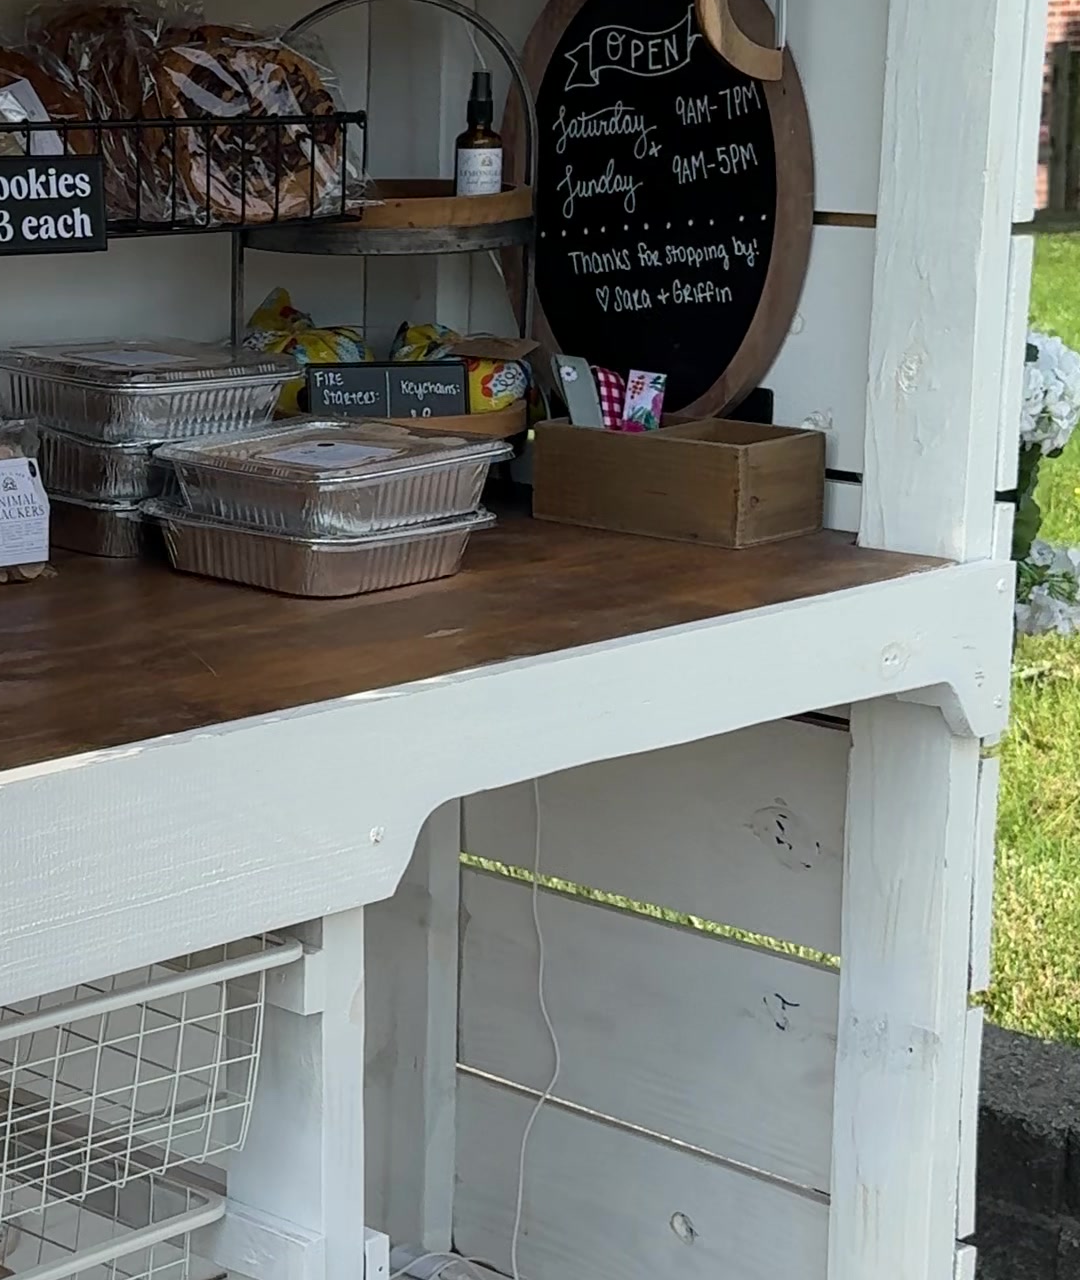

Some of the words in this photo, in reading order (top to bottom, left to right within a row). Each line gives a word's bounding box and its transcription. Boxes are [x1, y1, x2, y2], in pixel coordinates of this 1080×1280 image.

[606, 31, 680, 70] OPEN
[552, 100, 658, 160] Saturday
[675, 80, 762, 126] 9AM-7PM
[556, 158, 644, 219] Sunday
[672, 142, 759, 185] 9AM-5PM
[21, 206, 94, 241] each
[568, 248, 632, 275] Thanks
[665, 243, 730, 270] stopping
[731, 235, 760, 268] by!
[314, 371, 344, 388] FIRE
[400, 379, 461, 401] Keychains:
